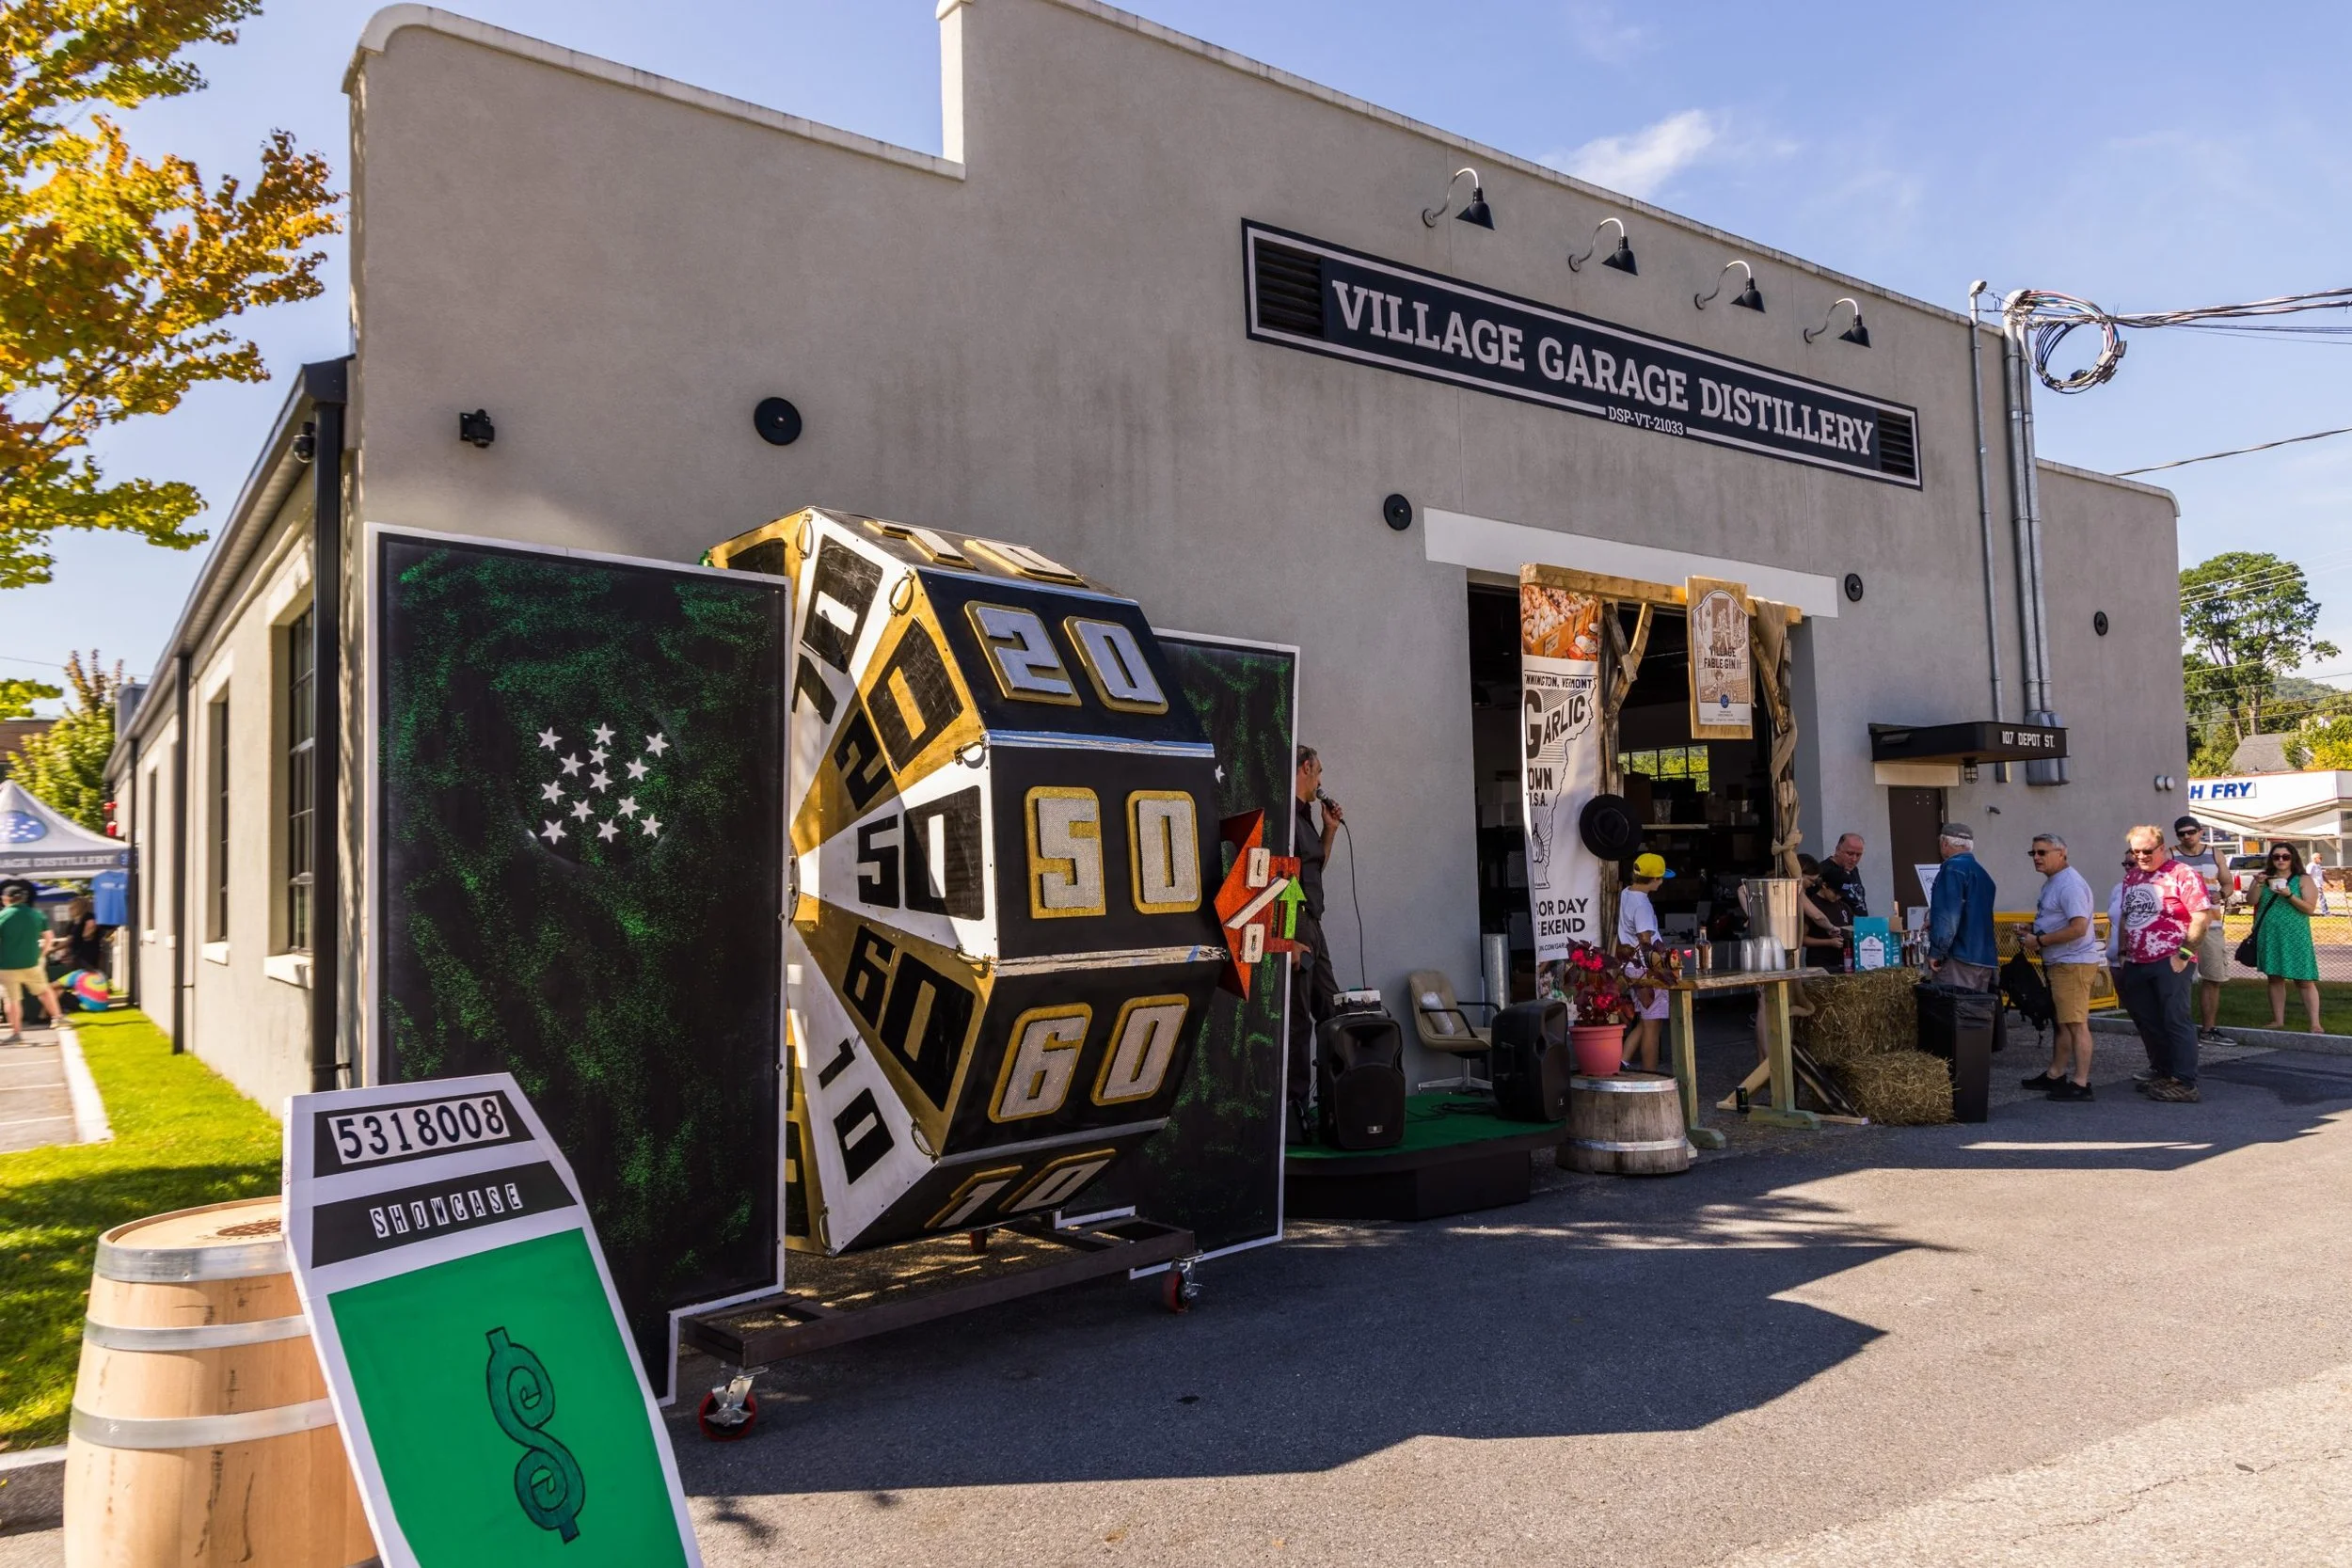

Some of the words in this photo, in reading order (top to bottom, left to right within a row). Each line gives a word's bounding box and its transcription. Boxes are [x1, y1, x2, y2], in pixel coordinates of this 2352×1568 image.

[1332, 281, 1525, 372] VILLAGE
[1538, 337, 1689, 412] GARAGE
[1700, 377, 1874, 456] DISTILLERY
[1608, 405, 1684, 436] DSP-VT-21033
[964, 599, 1169, 715] 20
[1525, 673, 1559, 689] NNINGTON,
[1563, 678, 1592, 689] VERMONT
[834, 615, 964, 812] 20
[1525, 689, 1585, 759] GARLIC
[2002, 731, 2014, 745] 107
[2018, 732, 2041, 747] DEPOT
[2044, 735, 2055, 748] ST.
[1528, 768, 1552, 790] OWN
[2211, 782, 2252, 798] FRY
[33, 855, 114, 866] DISTILLERY
[857, 784, 984, 921] 50
[1024, 786, 1200, 919] 50
[1558, 898, 1589, 914] DAY
[842, 925, 977, 1113] 60
[988, 993, 1189, 1124] 60
[337, 1097, 505, 1160] 5318008
[818, 1037, 895, 1185] 10
[370, 1182, 523, 1238] SHOWCASE
[924, 1148, 1117, 1229] 10
